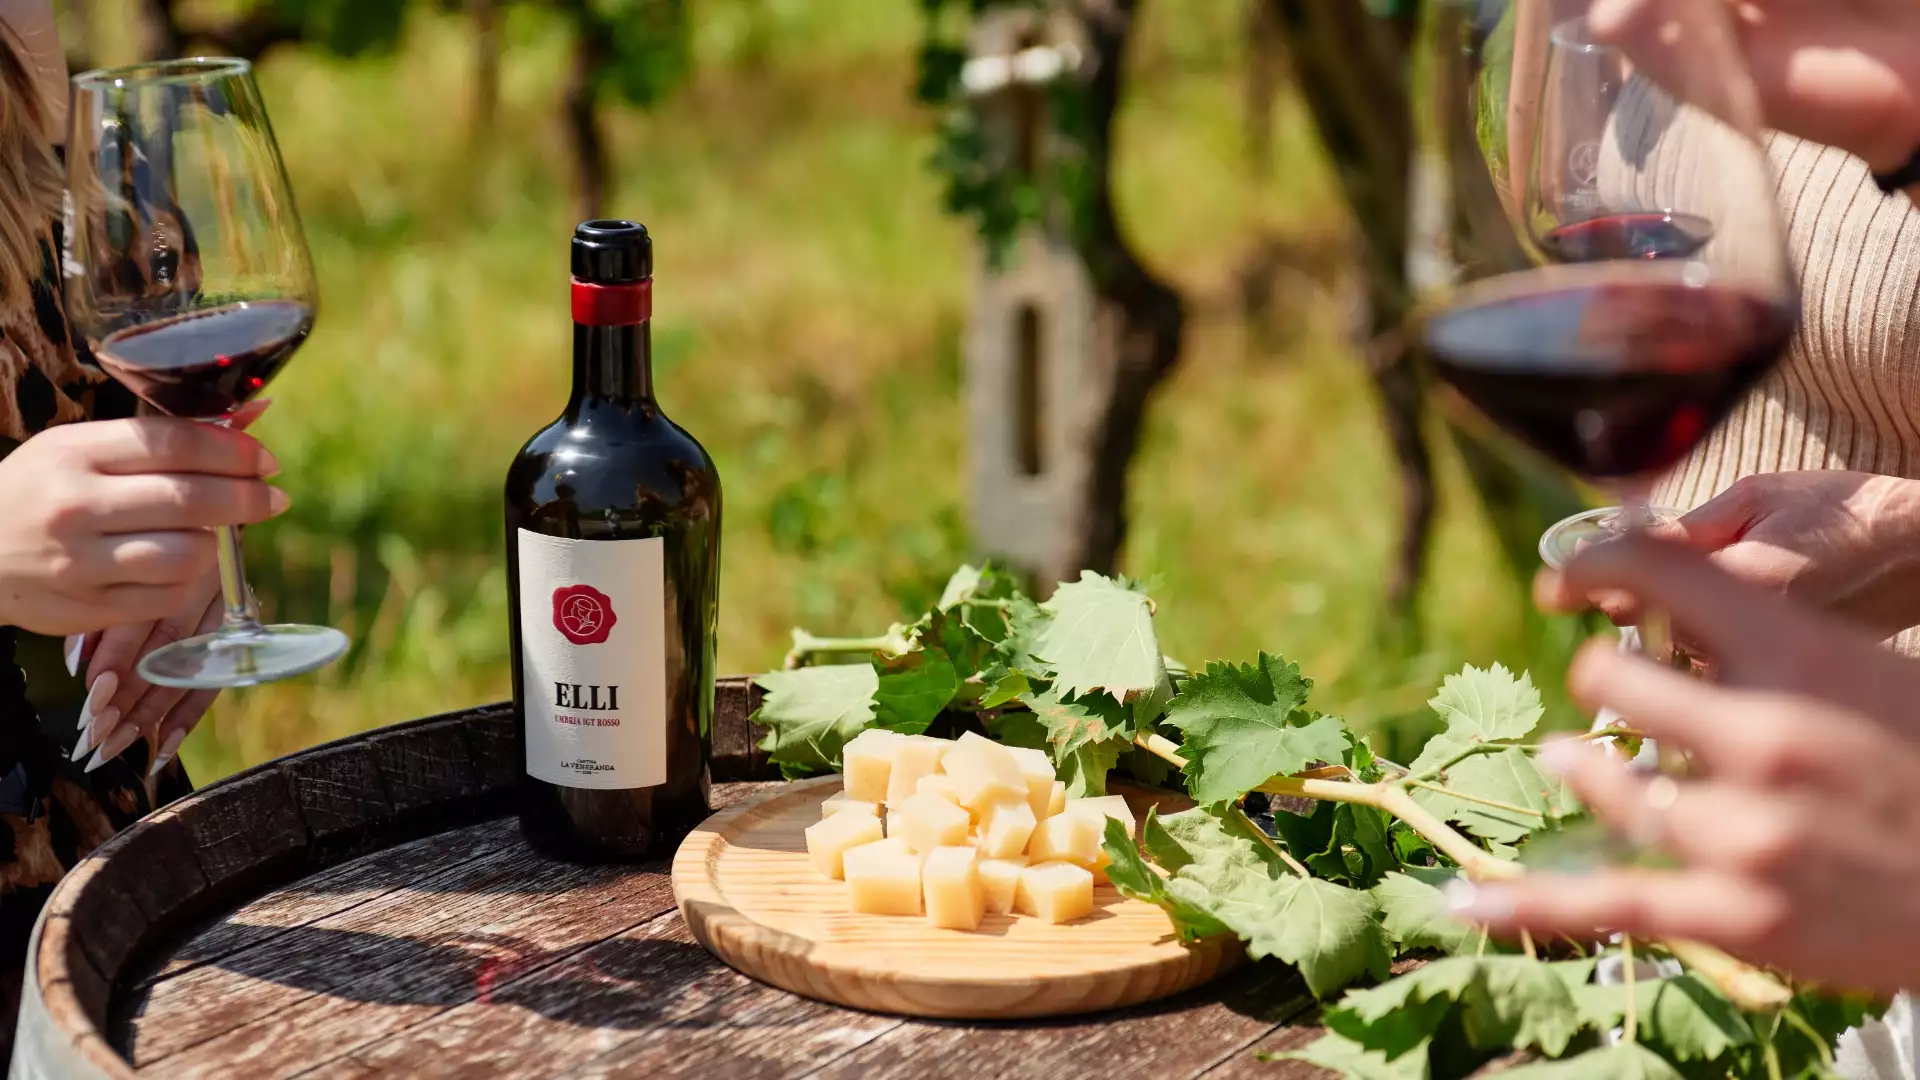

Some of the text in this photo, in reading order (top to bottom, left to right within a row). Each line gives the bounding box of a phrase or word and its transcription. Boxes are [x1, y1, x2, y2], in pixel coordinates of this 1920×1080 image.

[554, 682, 619, 710] ELLI
[555, 714, 620, 727] UMBRIA IGT ROSSO
[570, 762, 615, 771] VENERANDA
